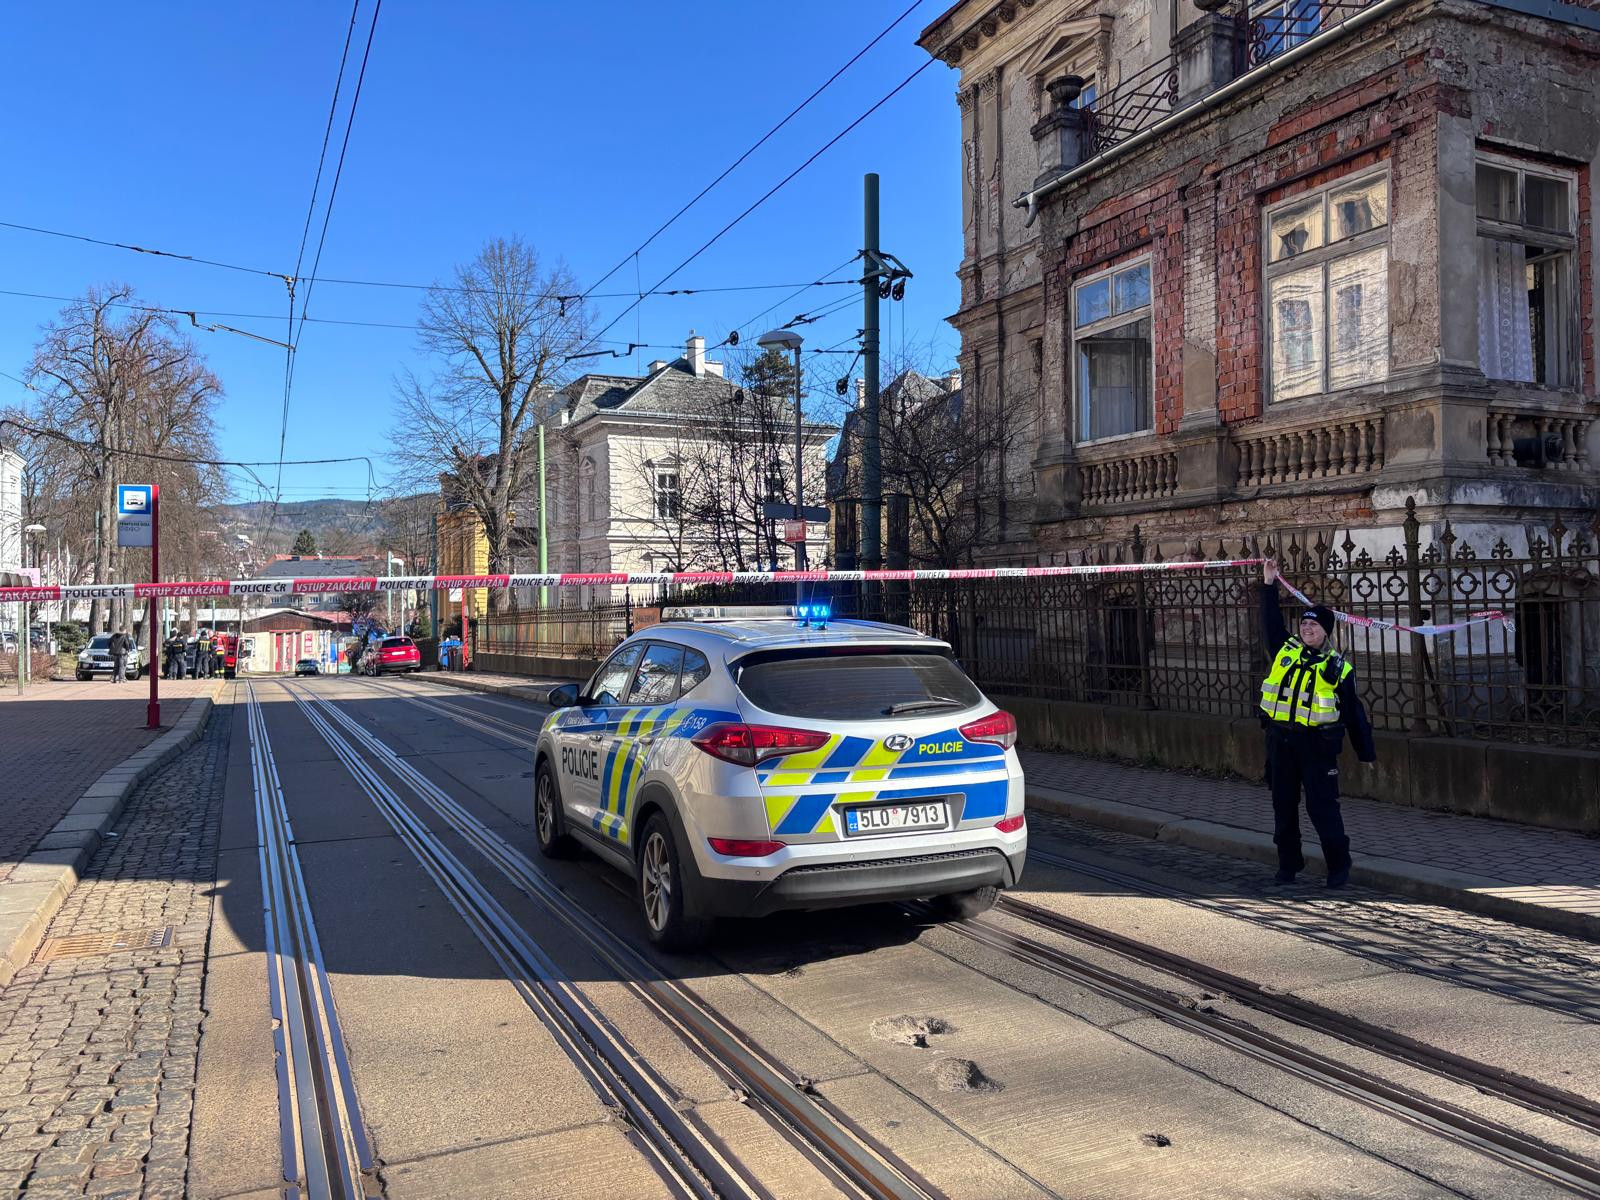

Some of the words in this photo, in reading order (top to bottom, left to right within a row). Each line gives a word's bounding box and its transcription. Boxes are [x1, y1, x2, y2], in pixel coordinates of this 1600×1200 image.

[233, 583, 270, 593] POLICIE
[273, 581, 287, 593] ČR
[296, 582, 325, 592] VSTUP
[326, 579, 371, 592] ZAKÁZÁN
[379, 580, 412, 590] POLICIE
[415, 578, 427, 589] ČR
[436, 579, 462, 588] VSTUP
[463, 576, 504, 588] ZAKÁZÁN
[511, 578, 542, 587] POLICIE
[543, 576, 555, 587] ČR
[65, 588, 107, 598] POLICIE
[111, 586, 126, 597] ČR
[138, 586, 171, 597] VSTUP
[173, 584, 224, 596] ZAKÁZÁN
[690, 716, 707, 730] 158
[918, 741, 964, 755] POLICIE
[562, 747, 598, 780] POLICIE
[860, 808, 890, 828] 5L0
[902, 805, 939, 825] 7913
